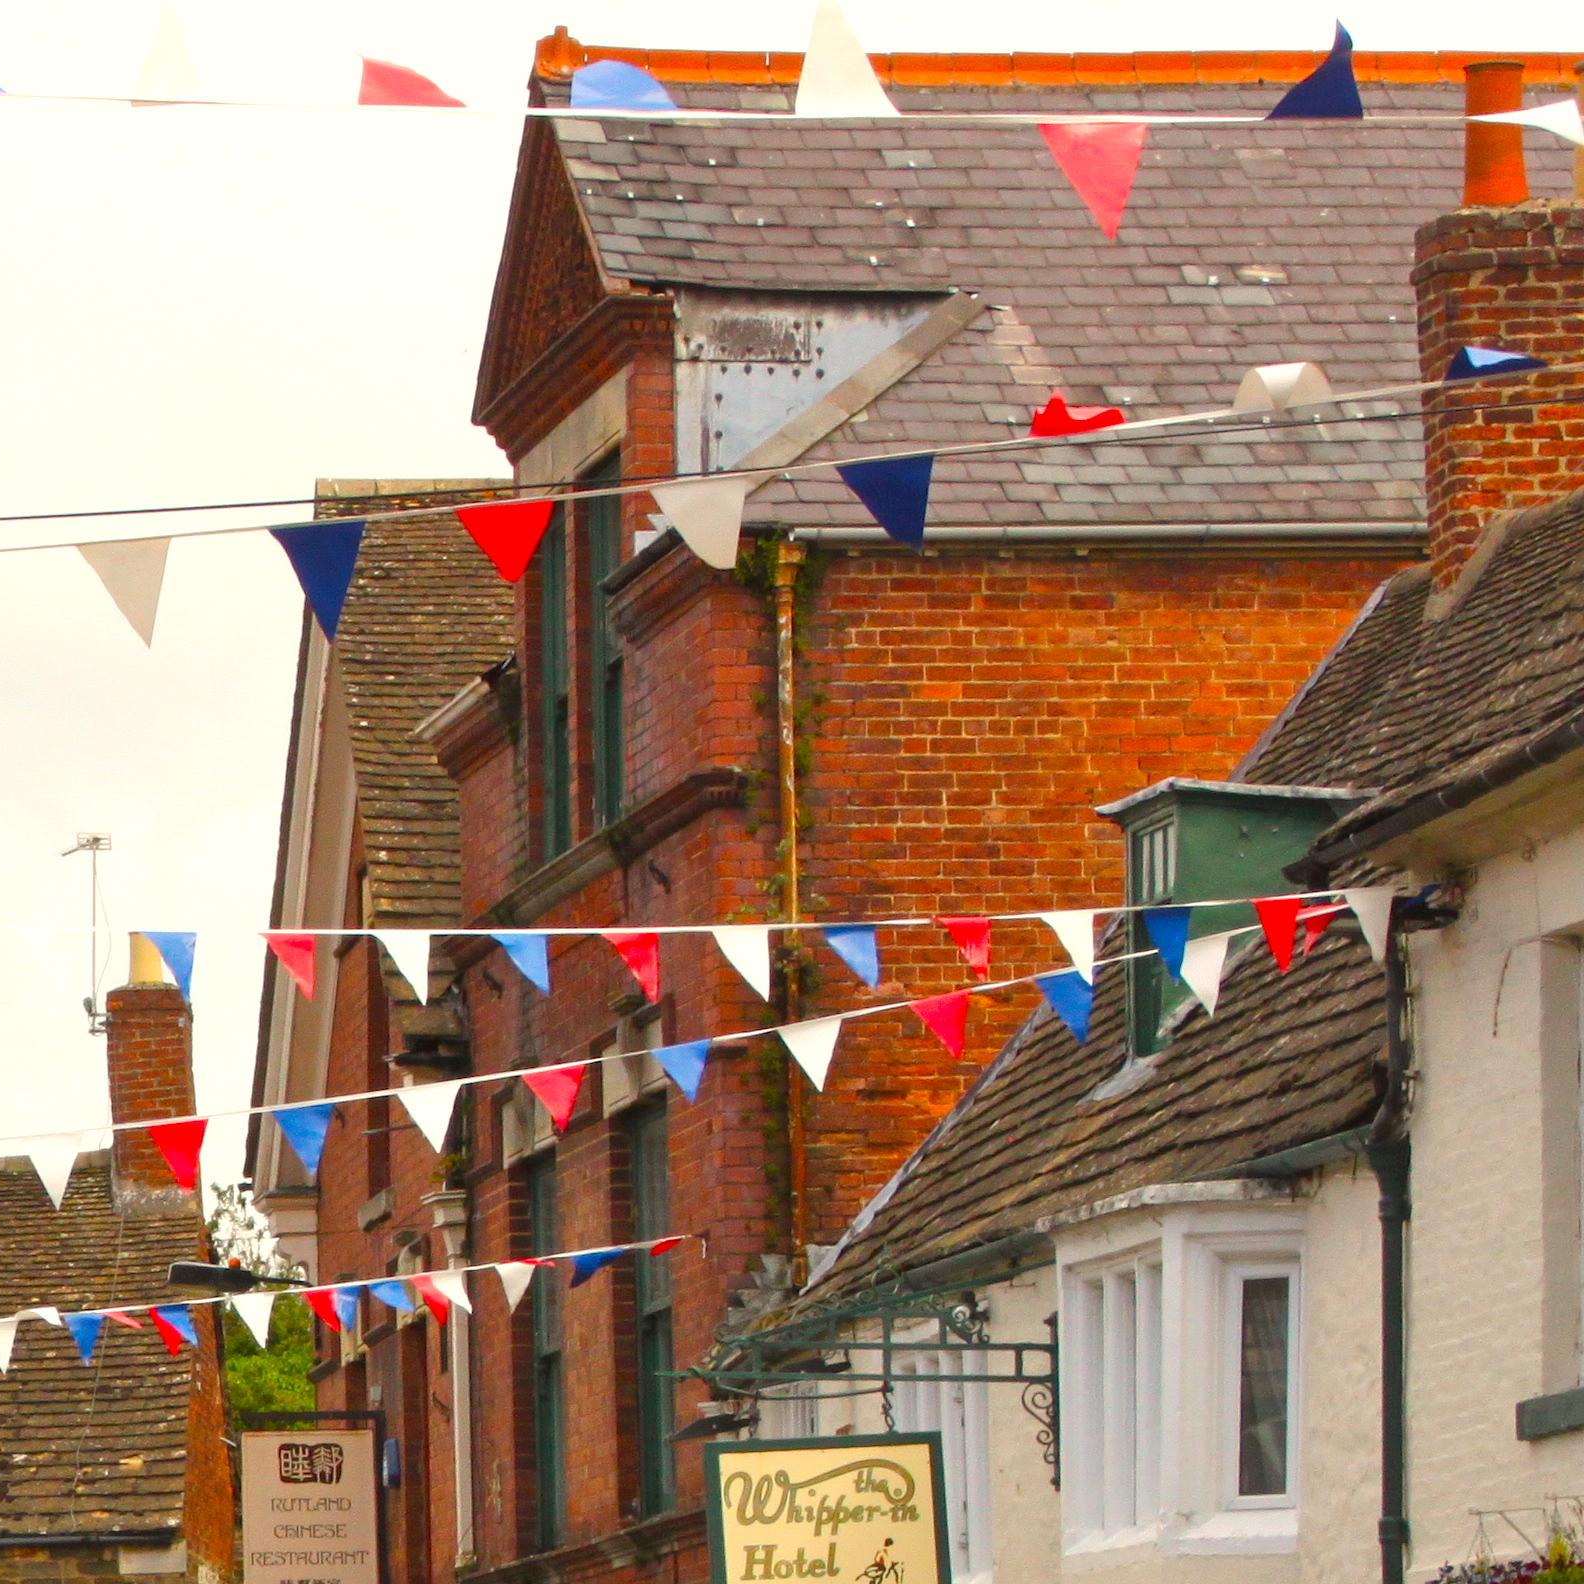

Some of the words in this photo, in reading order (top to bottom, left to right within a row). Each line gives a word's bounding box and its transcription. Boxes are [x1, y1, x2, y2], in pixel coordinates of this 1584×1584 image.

[853, 1468, 893, 1495] the
[271, 1497, 352, 1512] RUTLAND
[724, 1460, 920, 1537] Whipper-in
[273, 1523, 348, 1539] CHINESE
[250, 1551, 369, 1566] RESTAURANT
[740, 1542, 840, 1581] Hotel
